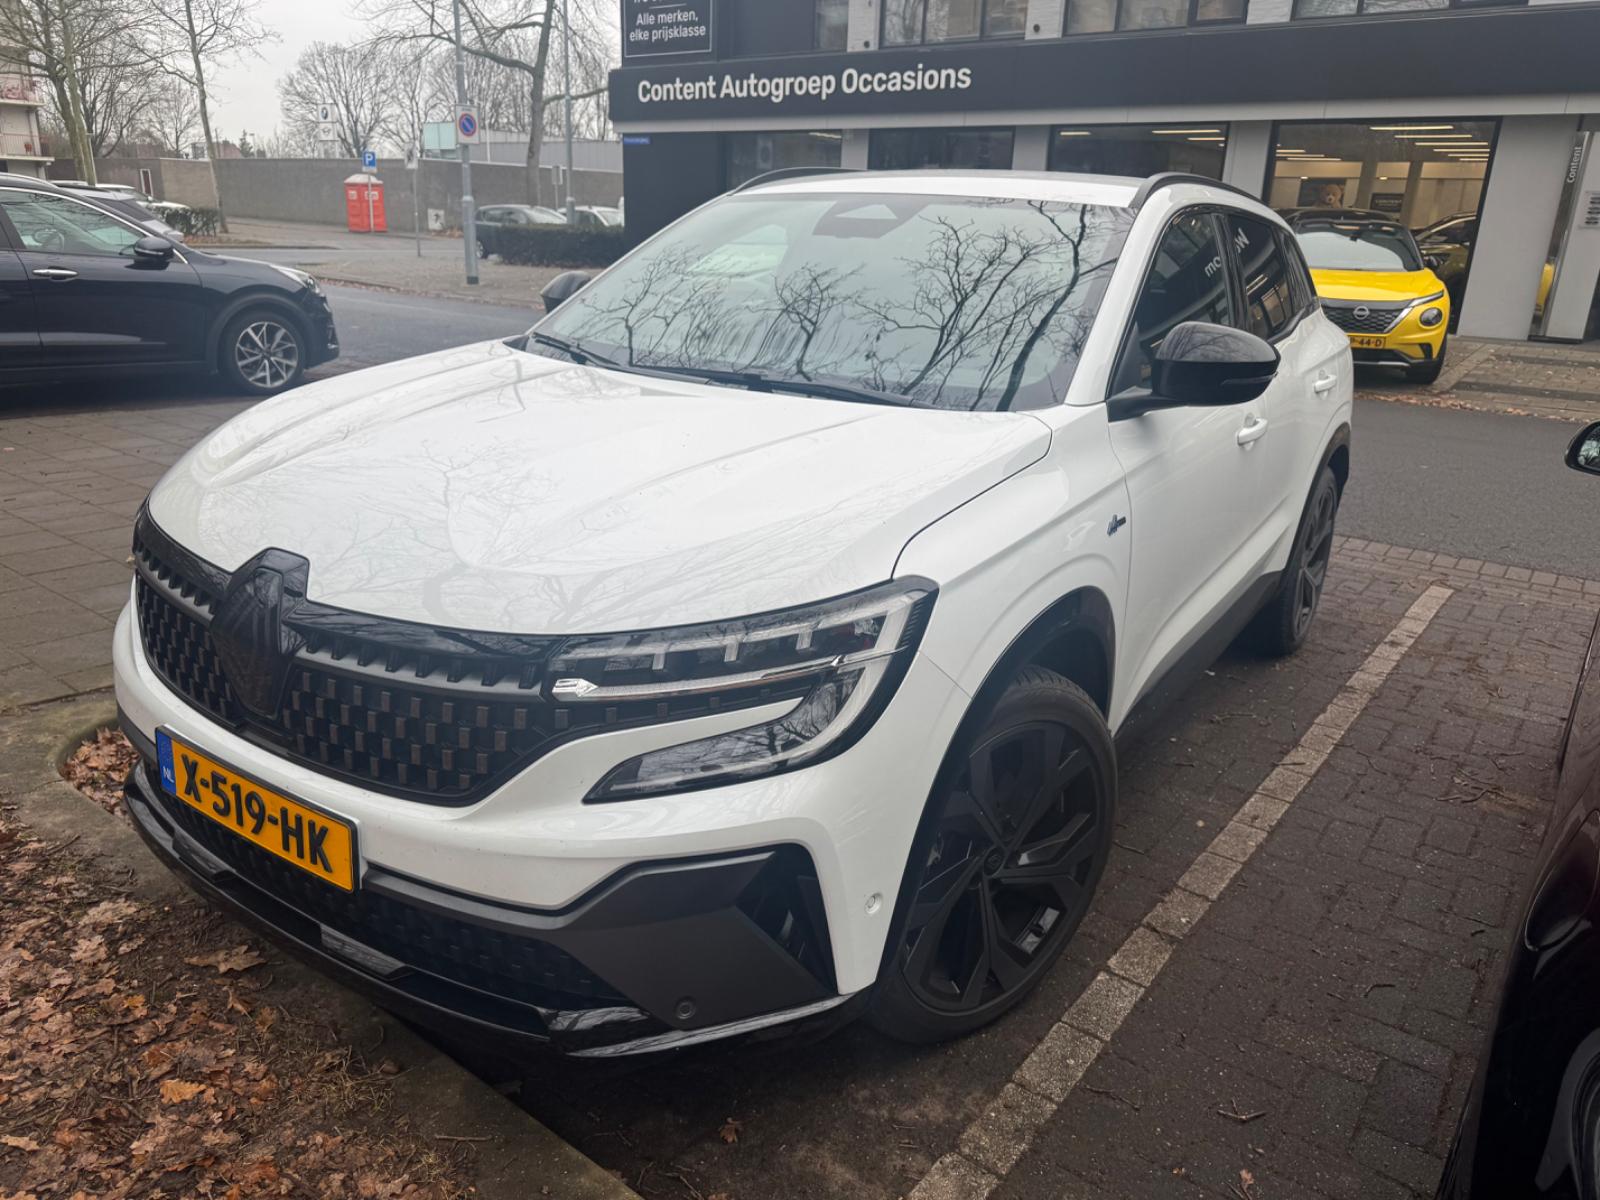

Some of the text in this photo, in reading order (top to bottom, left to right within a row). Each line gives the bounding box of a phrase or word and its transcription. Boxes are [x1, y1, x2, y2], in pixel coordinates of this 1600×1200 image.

[636, 9, 699, 26] Alle merken,
[629, 25, 707, 43] elke prijsklasse
[637, 64, 972, 103] Content Autogroep Occasions
[1567, 146, 1582, 183] Content
[162, 765, 175, 784] NL
[181, 753, 333, 874] X-519-HK
